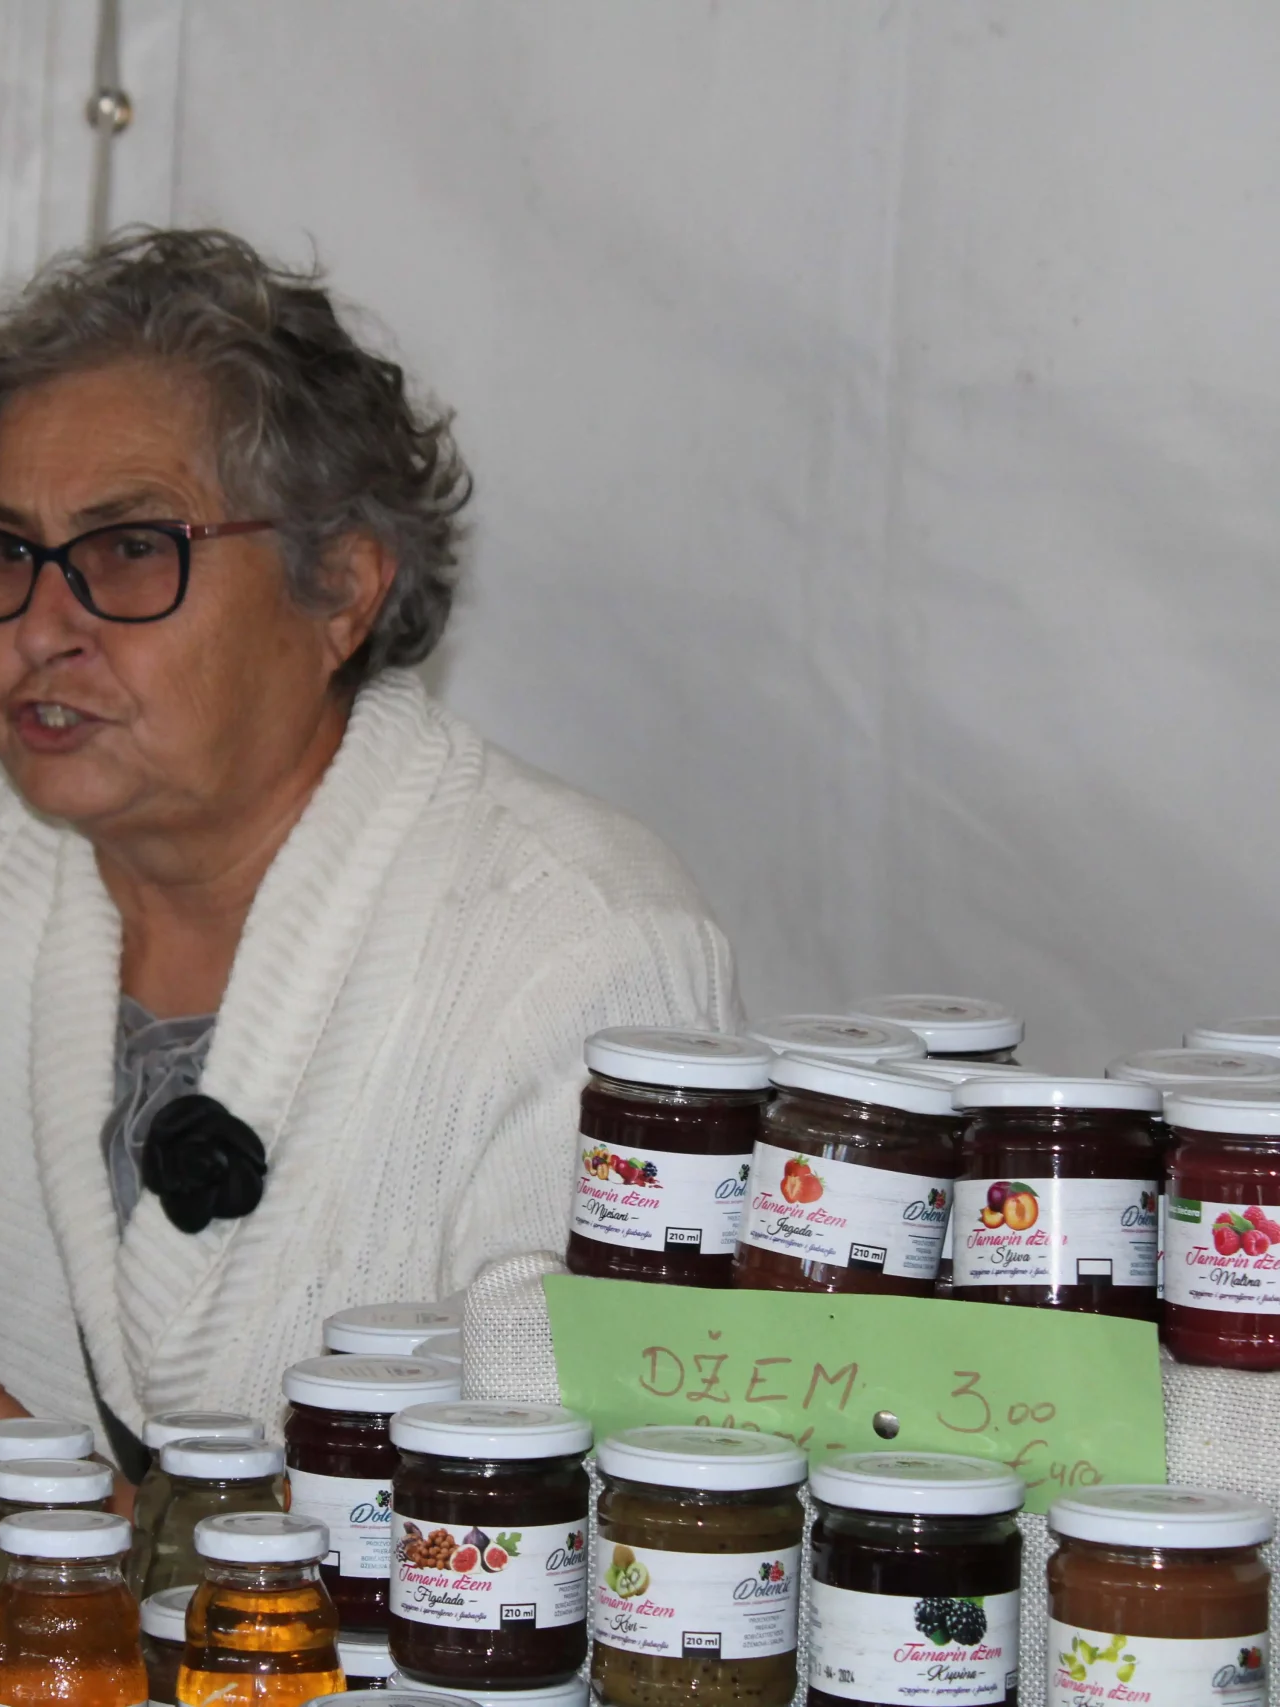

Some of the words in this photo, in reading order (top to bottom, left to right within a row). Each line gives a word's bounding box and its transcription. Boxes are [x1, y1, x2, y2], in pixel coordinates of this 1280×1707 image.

[576, 1176, 619, 1203] Tamarin
[621, 1190, 660, 1209] džem
[753, 1192, 803, 1219] Tamarin
[807, 1207, 848, 1228] džem
[669, 1232, 684, 1241] 210
[686, 1233, 699, 1242] ml
[767, 1217, 812, 1237] Jagoda
[967, 1228, 1021, 1249] Tamarin
[853, 1247, 869, 1258] 210
[871, 1251, 883, 1261] ml
[990, 1245, 1031, 1267] Šljiva
[1186, 1246, 1249, 1268] Tamarin
[1252, 1252, 1280, 1270] dže
[1210, 1267, 1262, 1288] Malina
[936, 1370, 1056, 1434] 3.00
[350, 1503, 392, 1523] Dole
[399, 1563, 449, 1588] Tamarin
[452, 1574, 493, 1592] džem
[413, 1585, 465, 1608] Figolada
[504, 1608, 520, 1618] 210
[523, 1608, 534, 1618] ml
[636, 1599, 675, 1618] džem
[686, 1637, 702, 1646] 210
[704, 1637, 718, 1646] ml
[894, 1643, 967, 1663] Tamarin
[970, 1644, 1003, 1662] džem
[927, 1664, 977, 1684] Kupina
[1107, 1683, 1152, 1703] džem
